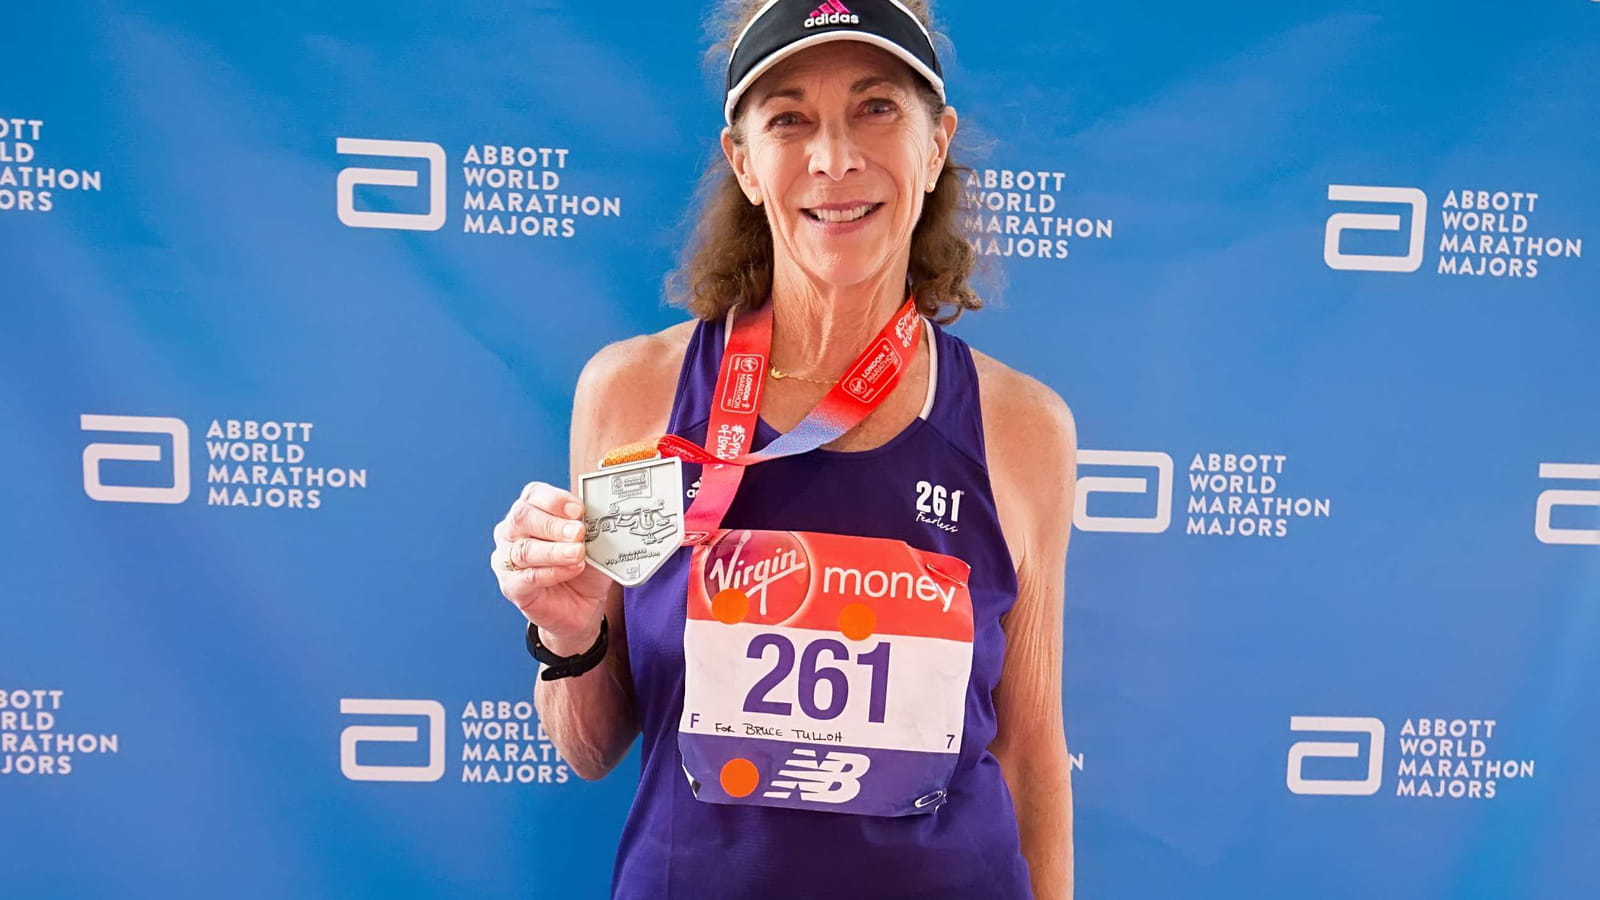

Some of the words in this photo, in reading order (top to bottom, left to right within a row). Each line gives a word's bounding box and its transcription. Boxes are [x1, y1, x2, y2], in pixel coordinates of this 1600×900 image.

[803, 12, 859, 28] adidas
[463, 145, 569, 169] ABBOTT
[0, 166, 101, 191] ATHON
[463, 167, 560, 191] WORLD
[965, 169, 1066, 192] ABBOTT
[0, 189, 52, 211] ORS
[463, 190, 621, 217] MARATHON
[965, 190, 1056, 213] WORLD
[1443, 190, 1538, 212] ABBOTT
[463, 213, 575, 238] MAJORS
[965, 214, 1113, 238] MARATHON
[1442, 211, 1528, 234] WORLD
[966, 237, 1069, 259] MAJORS
[1439, 233, 1582, 258] MARATHON
[1437, 255, 1538, 278] MAJORS
[861, 352, 886, 379] LONDON
[866, 350, 897, 383] MARATHON
[733, 373, 746, 409] MARATHON
[741, 374, 753, 402] LONDON
[206, 419, 313, 442] ABBOTT
[206, 441, 305, 464] WORLD
[1189, 453, 1287, 474] ABBOTT
[207, 464, 367, 488] MARATHON
[1188, 473, 1277, 495] WORLD
[207, 487, 321, 509] MAJORS
[916, 480, 961, 522] 261
[1187, 495, 1331, 518] MARATHON
[915, 511, 959, 533] Fearless
[1186, 516, 1287, 538] MAJORS
[709, 531, 806, 616] Virgin
[822, 565, 956, 613] money
[742, 632, 892, 724] 261
[0, 689, 63, 710] BOTT
[462, 700, 533, 720] ABBO
[1, 711, 54, 731] RLD
[690, 713, 700, 728] F
[1400, 718, 1496, 738] ABBOTT
[1, 732, 118, 753] RATHON
[742, 722, 784, 737] BRUCE
[791, 729, 843, 743] TULLOH
[945, 734, 955, 749] 7
[462, 743, 561, 762] MARAT
[1399, 737, 1486, 758] WORLD
[0, 754, 72, 775] JORS
[462, 764, 569, 783] MAJORS
[1397, 758, 1535, 779] MARATHON
[1396, 778, 1496, 799] MAJORS
